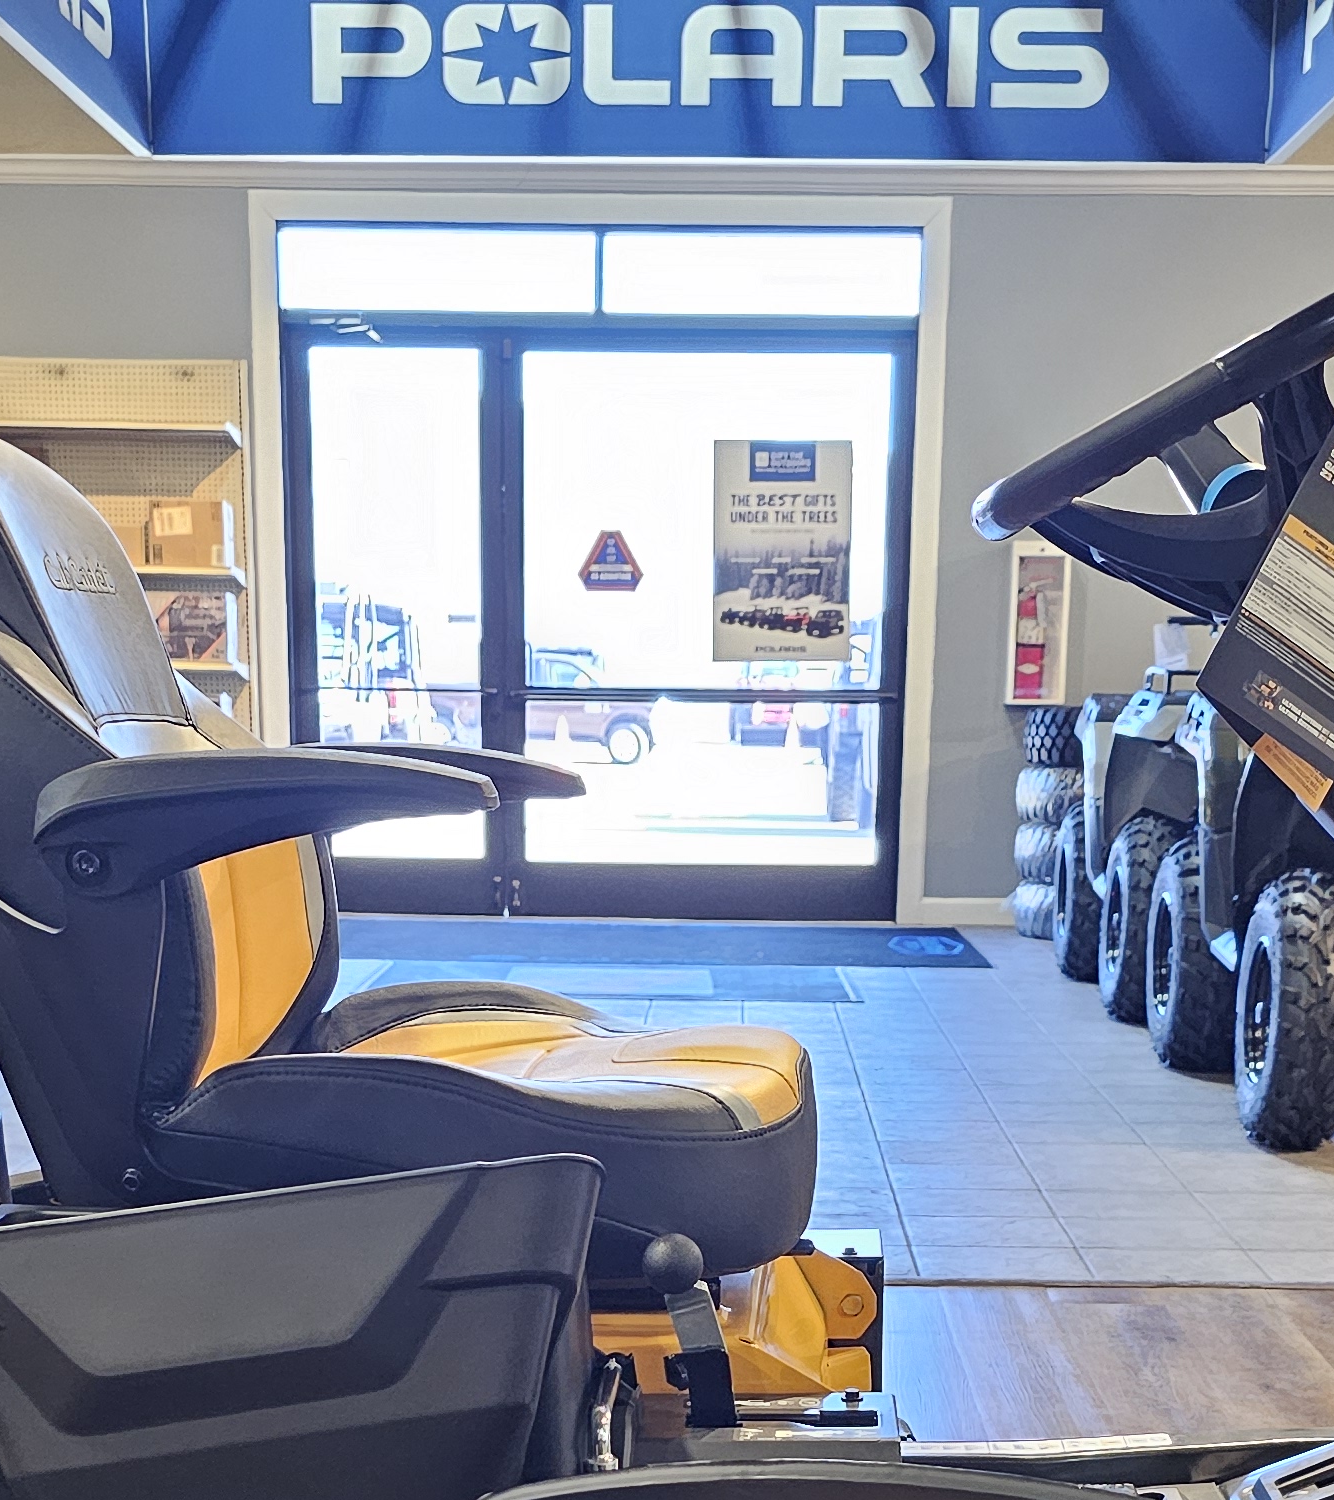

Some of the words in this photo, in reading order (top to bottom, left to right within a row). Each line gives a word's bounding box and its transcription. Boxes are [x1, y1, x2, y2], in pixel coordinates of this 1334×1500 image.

[310, 3, 1110, 109] POLARIS
[731, 494, 751, 507] THE
[756, 493, 801, 507] BEST
[804, 494, 837, 507] GIFTS
[730, 511, 769, 524] UNDER
[774, 511, 796, 524] THE
[802, 511, 838, 524] TREES
